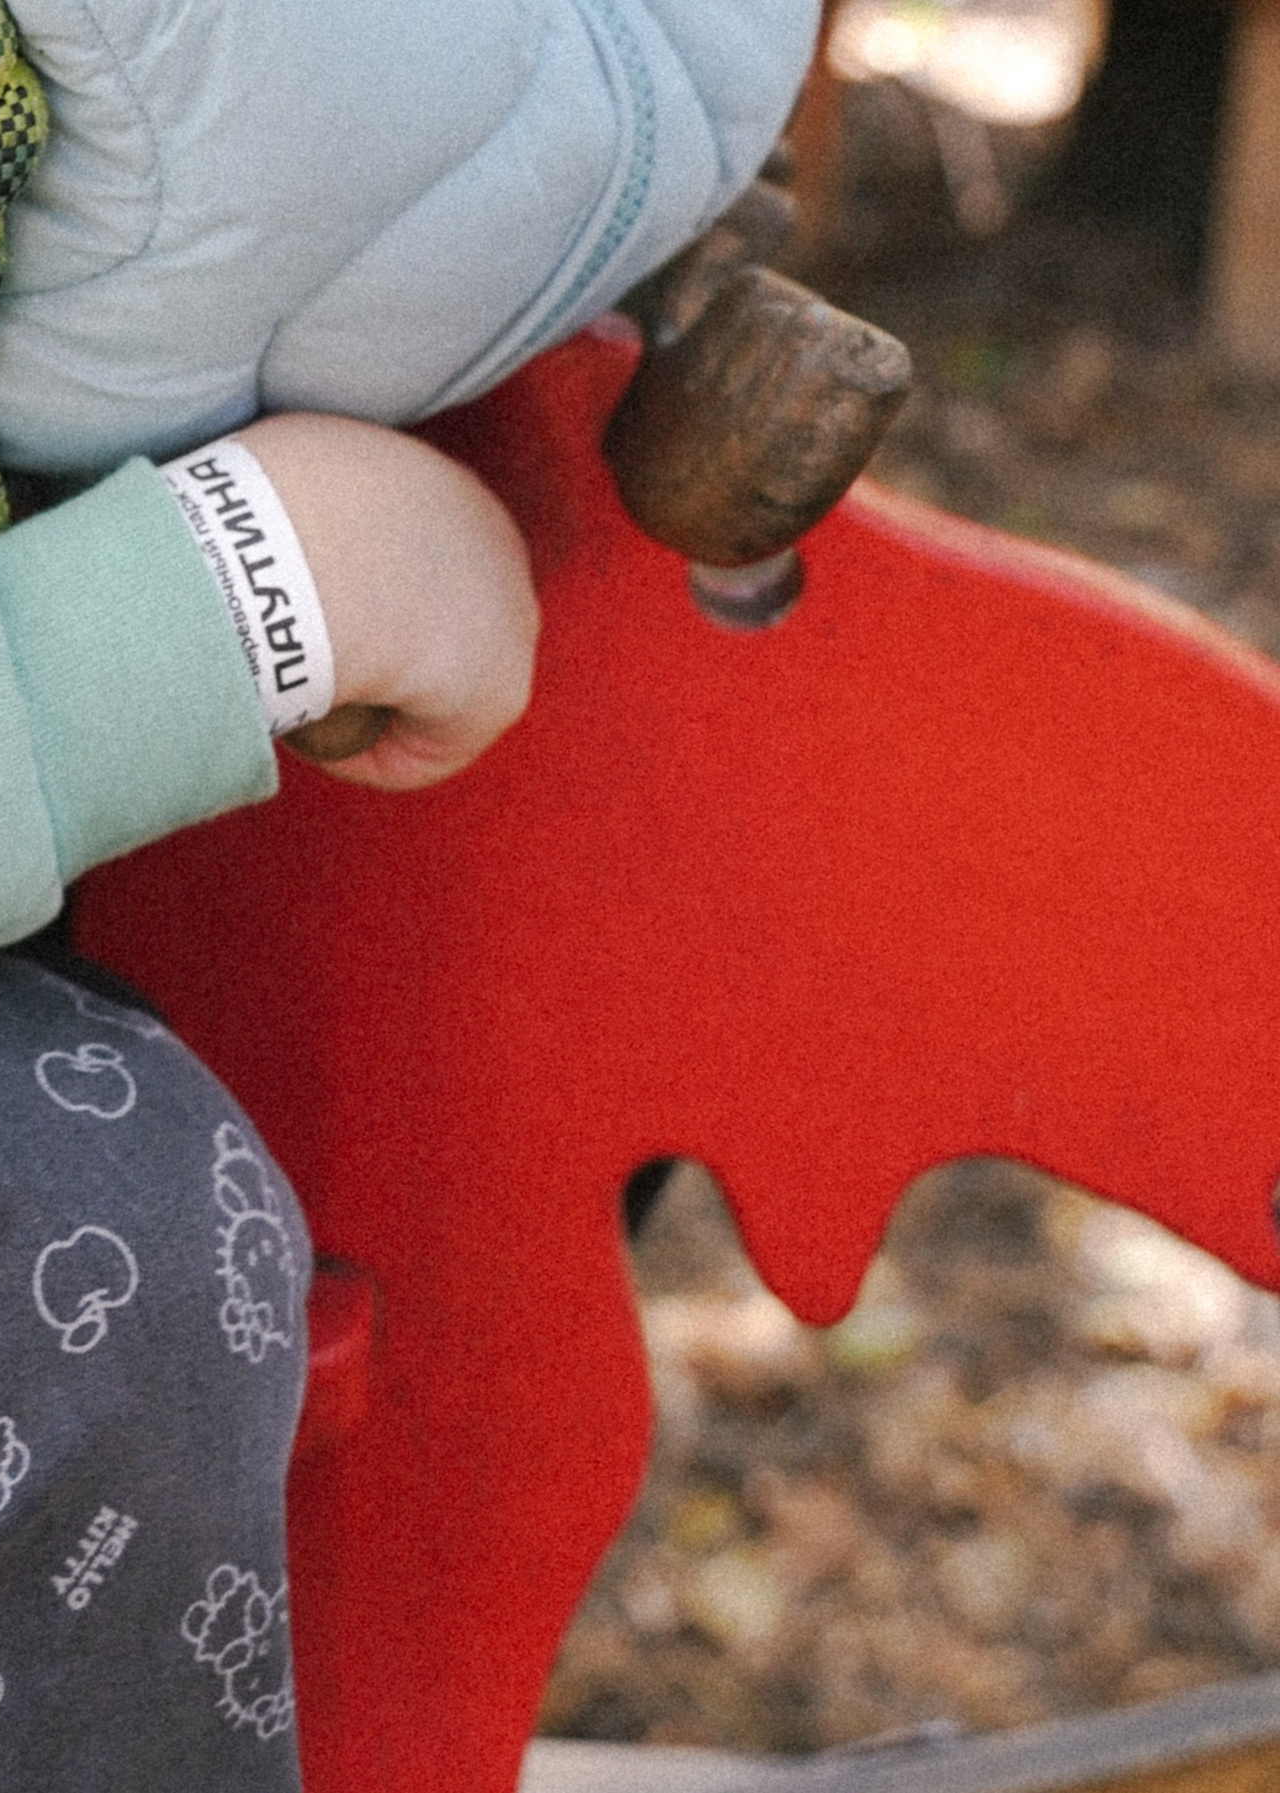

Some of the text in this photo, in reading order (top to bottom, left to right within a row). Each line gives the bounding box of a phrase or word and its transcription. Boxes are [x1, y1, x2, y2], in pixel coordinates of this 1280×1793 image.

[178, 492, 209, 536] парк
[187, 457, 309, 694] ПАУТИНА
[50, 1506, 118, 1595] KITTY
[67, 1515, 138, 1610] HELLO
